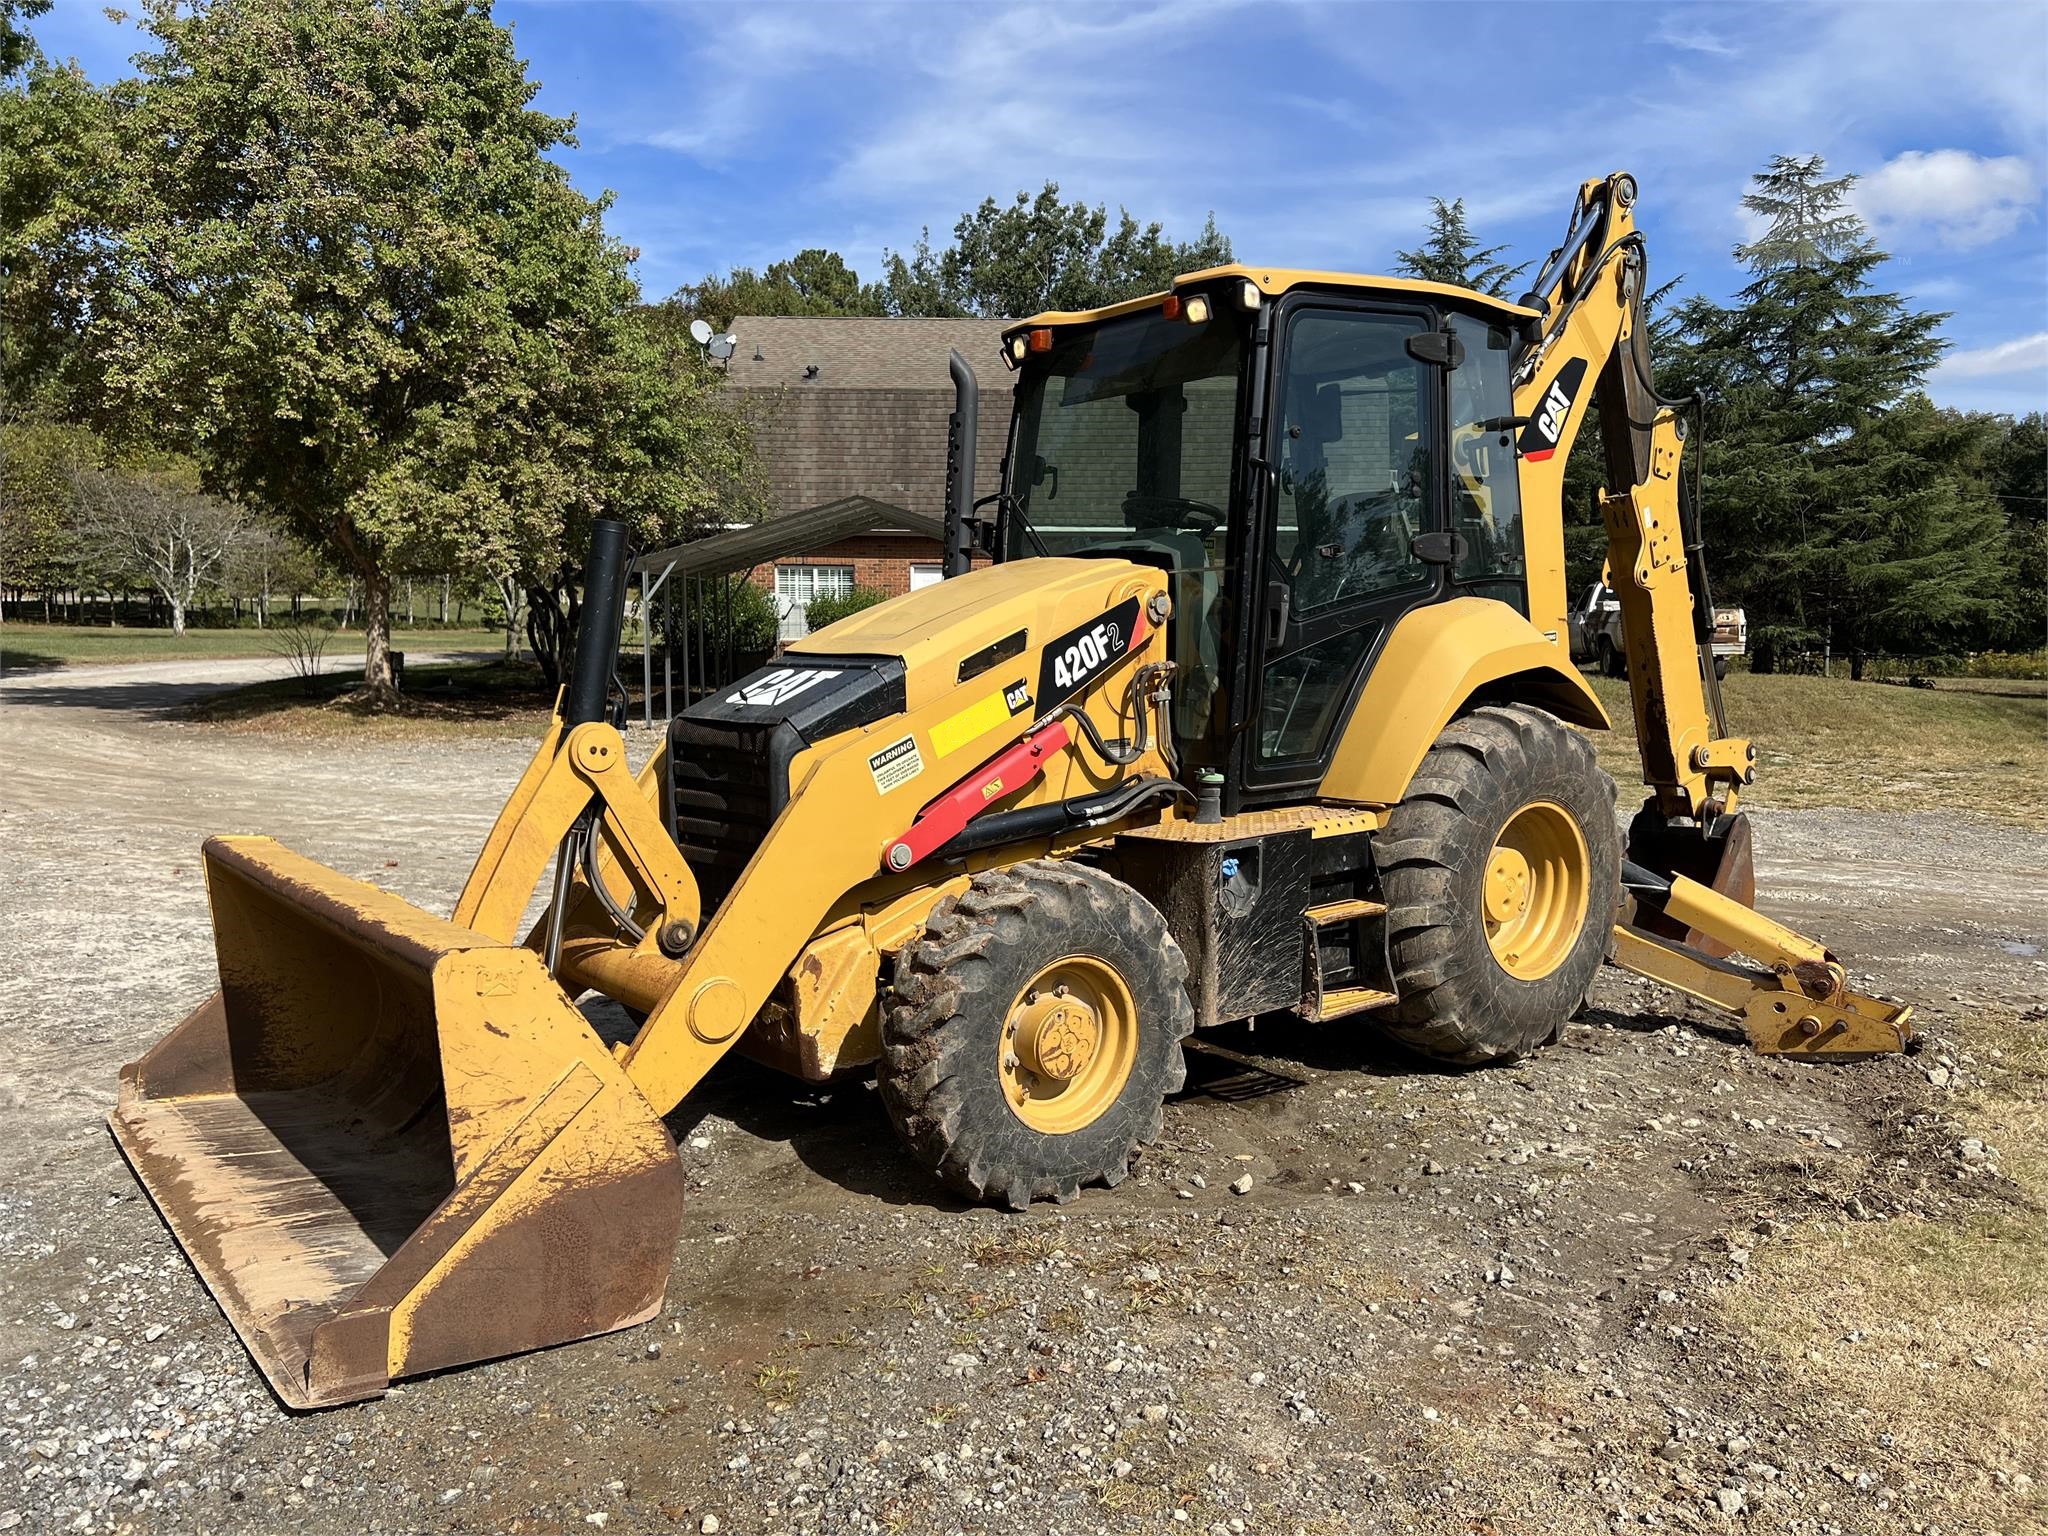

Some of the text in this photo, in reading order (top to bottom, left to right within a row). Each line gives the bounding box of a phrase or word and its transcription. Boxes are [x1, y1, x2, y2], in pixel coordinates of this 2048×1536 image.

[1538, 380, 1572, 444] CAT
[1054, 622, 1124, 688] 420F2
[725, 668, 844, 706] CAT
[1006, 685, 1029, 710] CAT
[871, 740, 913, 768] WARNING
